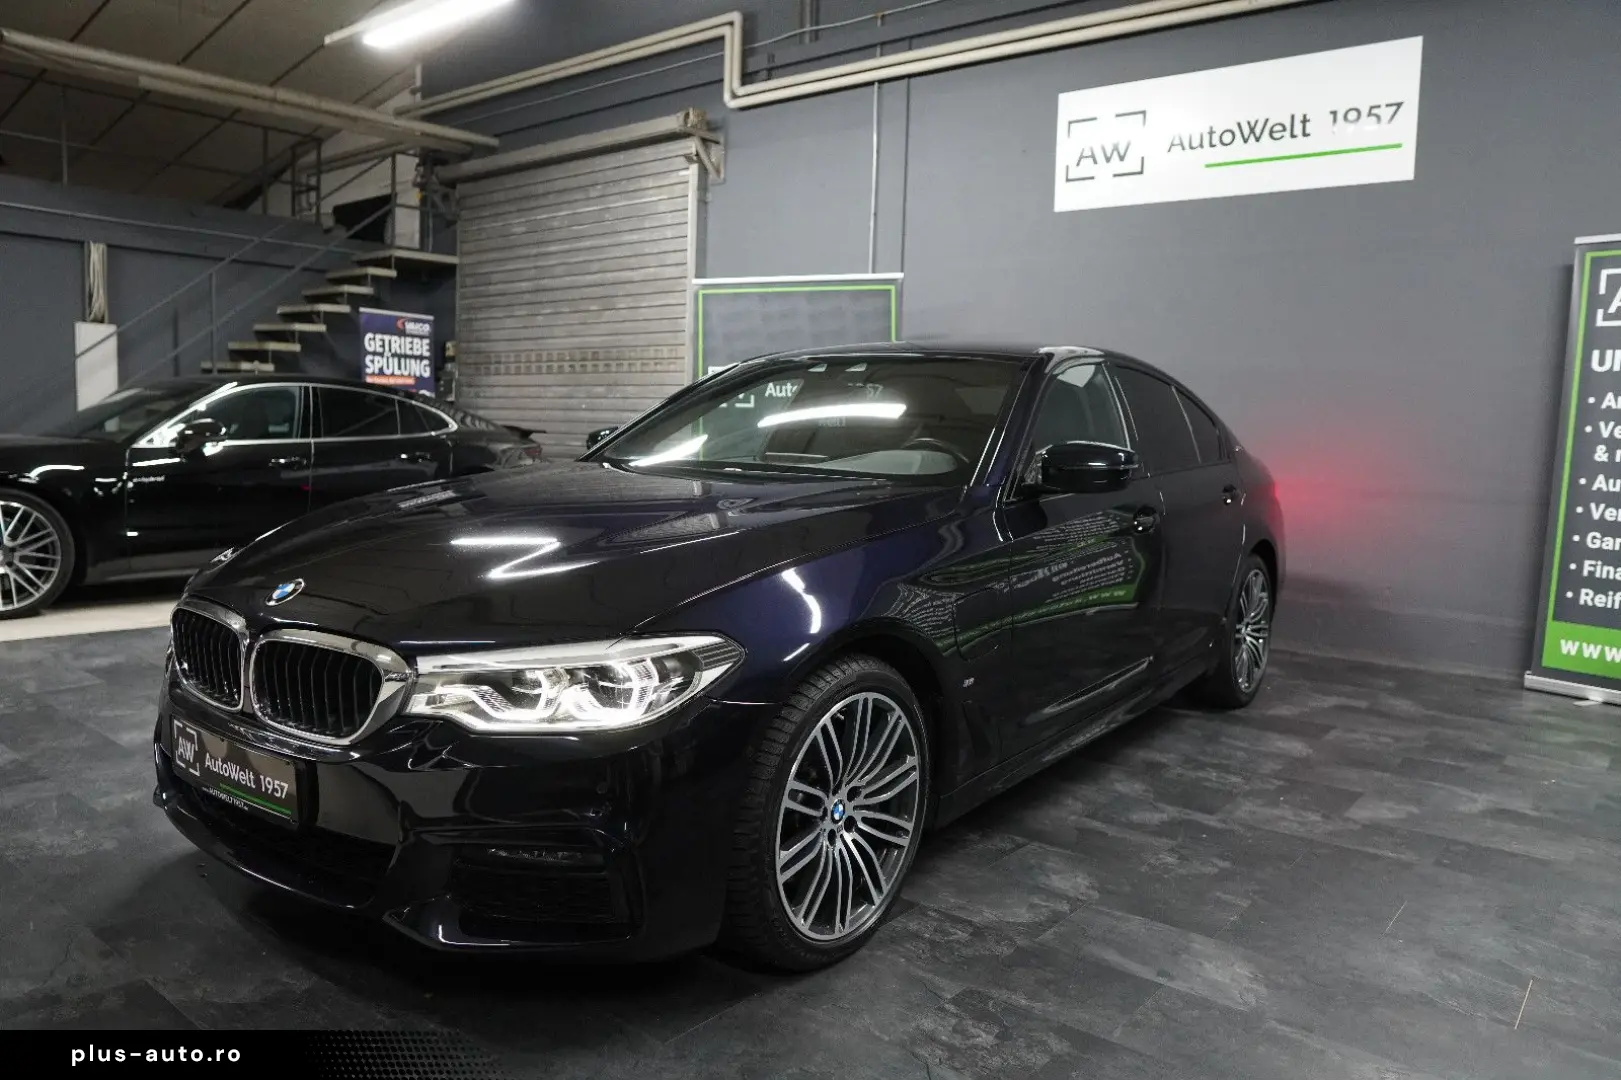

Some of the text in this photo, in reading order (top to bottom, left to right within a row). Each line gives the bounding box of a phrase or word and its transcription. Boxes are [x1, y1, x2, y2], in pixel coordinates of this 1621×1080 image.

[1167, 113, 1312, 153] AutoWelt
[1076, 139, 1132, 168] AW
[364, 332, 431, 357] GETRIEBE
[365, 352, 431, 378] SPÜLUNG
[1594, 445, 1609, 463] &
[1586, 531, 1621, 551] Gar
[1579, 587, 1621, 610] Reif
[177, 736, 195, 763] AW
[204, 753, 289, 800] AutoWelt 1957
